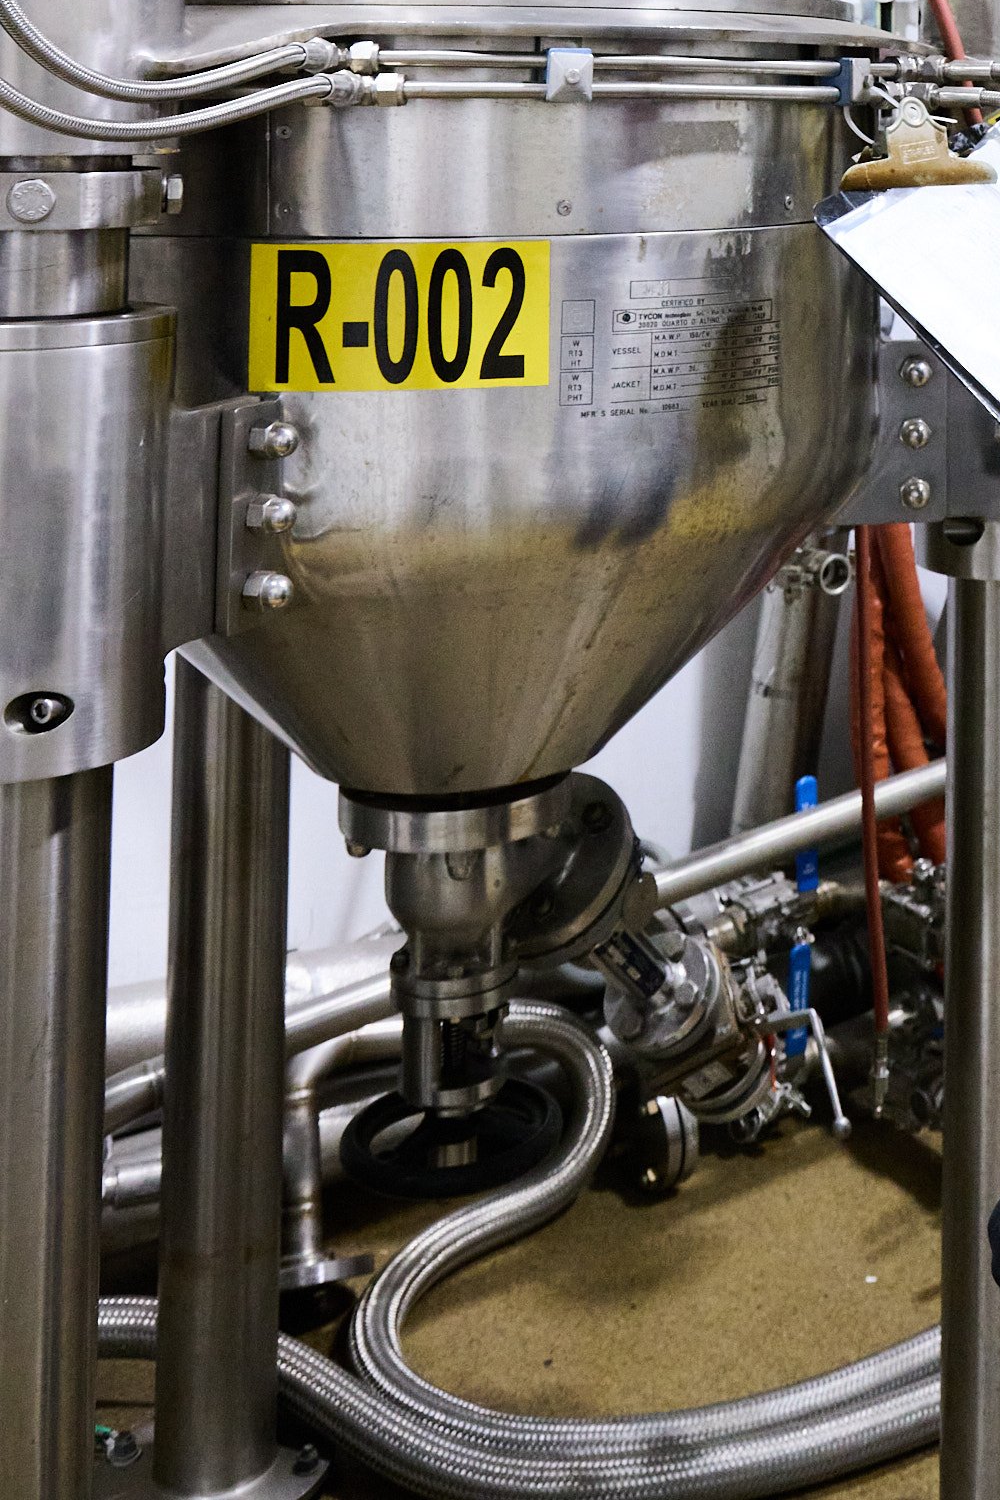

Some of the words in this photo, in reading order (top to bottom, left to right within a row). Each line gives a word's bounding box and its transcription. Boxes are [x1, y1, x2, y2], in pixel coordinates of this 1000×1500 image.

[274, 246, 526, 385] R-002
[612, 347, 641, 355] VESSEL
[611, 380, 641, 389] JACKET
[610, 408, 635, 416] SERIAL
